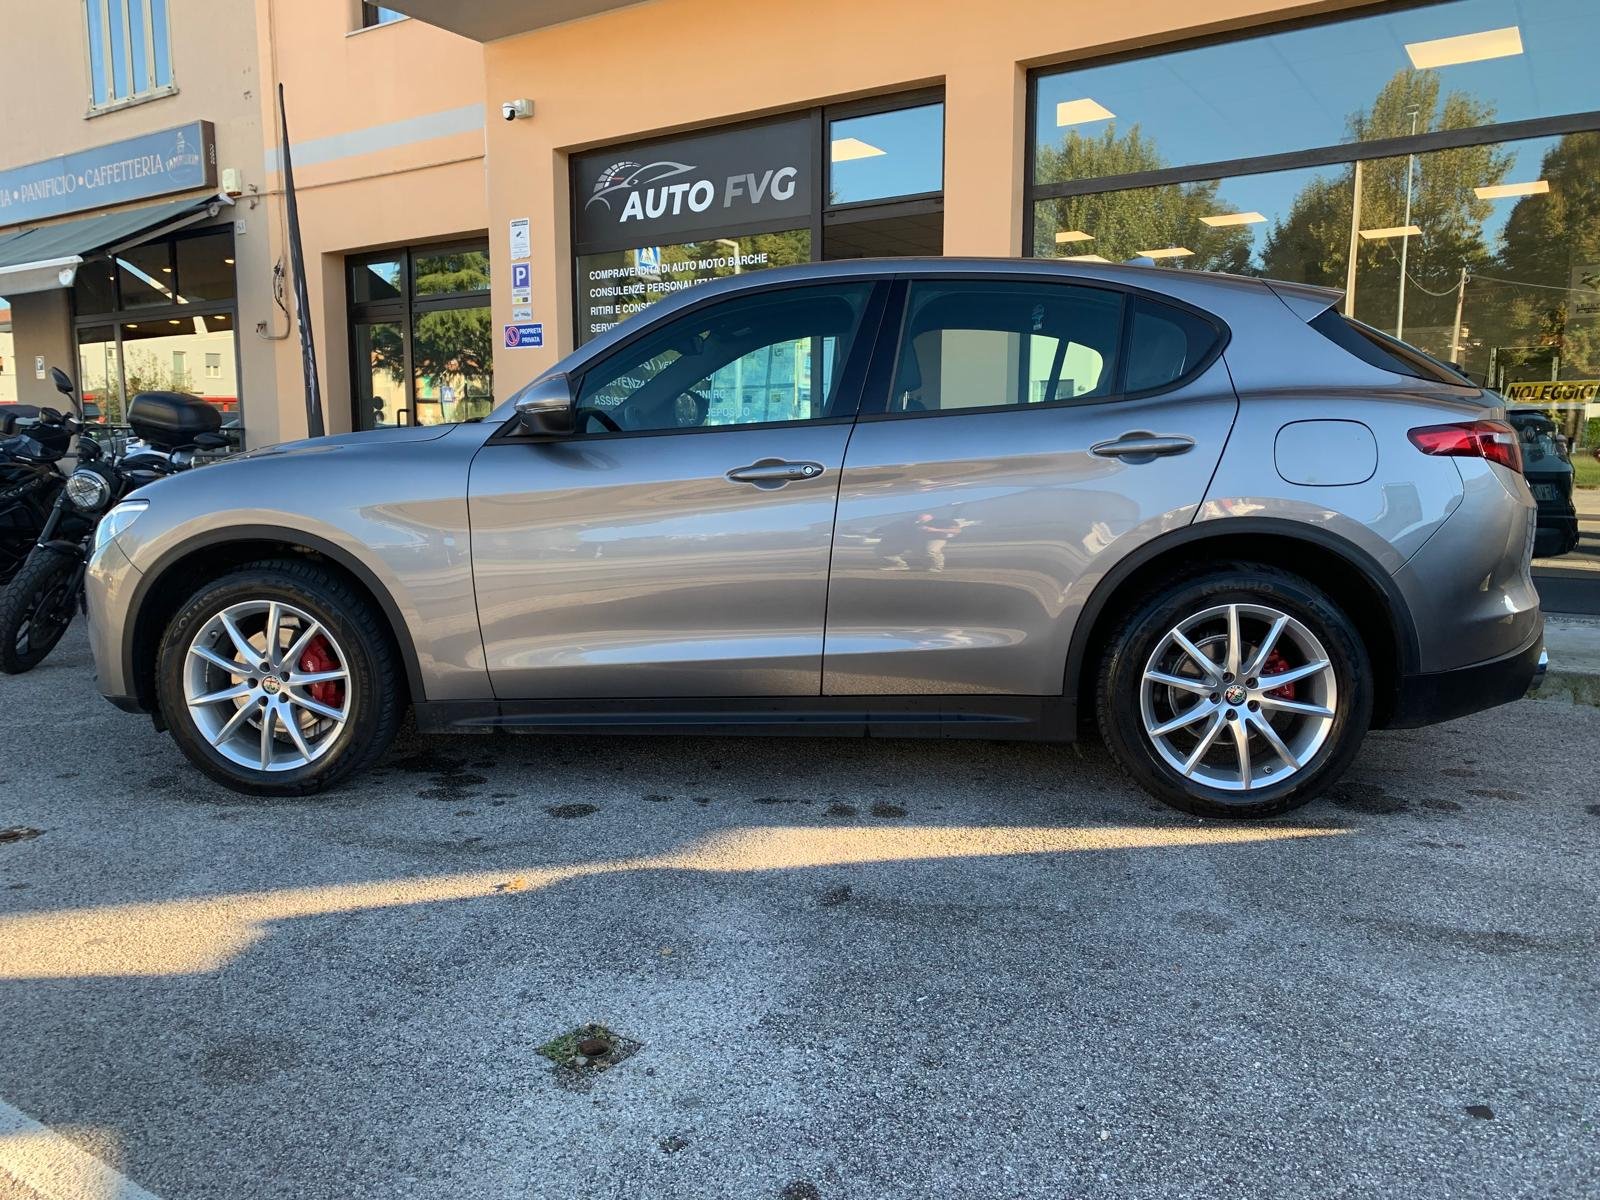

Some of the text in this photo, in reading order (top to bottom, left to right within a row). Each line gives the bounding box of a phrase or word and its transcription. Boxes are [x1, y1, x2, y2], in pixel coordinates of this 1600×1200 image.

[20, 174, 77, 203] PANIFICIO
[84, 153, 164, 189] CAFFETTERIA
[619, 166, 798, 223] AUTO FVG
[515, 267, 527, 286] P
[589, 252, 768, 281] COMPRAVENDITA DI AUTO MOTO BARCHE
[589, 277, 721, 299] CONSULENZE PERSONALI
[590, 301, 657, 316] RITIRI E CONS
[1509, 384, 1594, 401] NOLEGGIO
